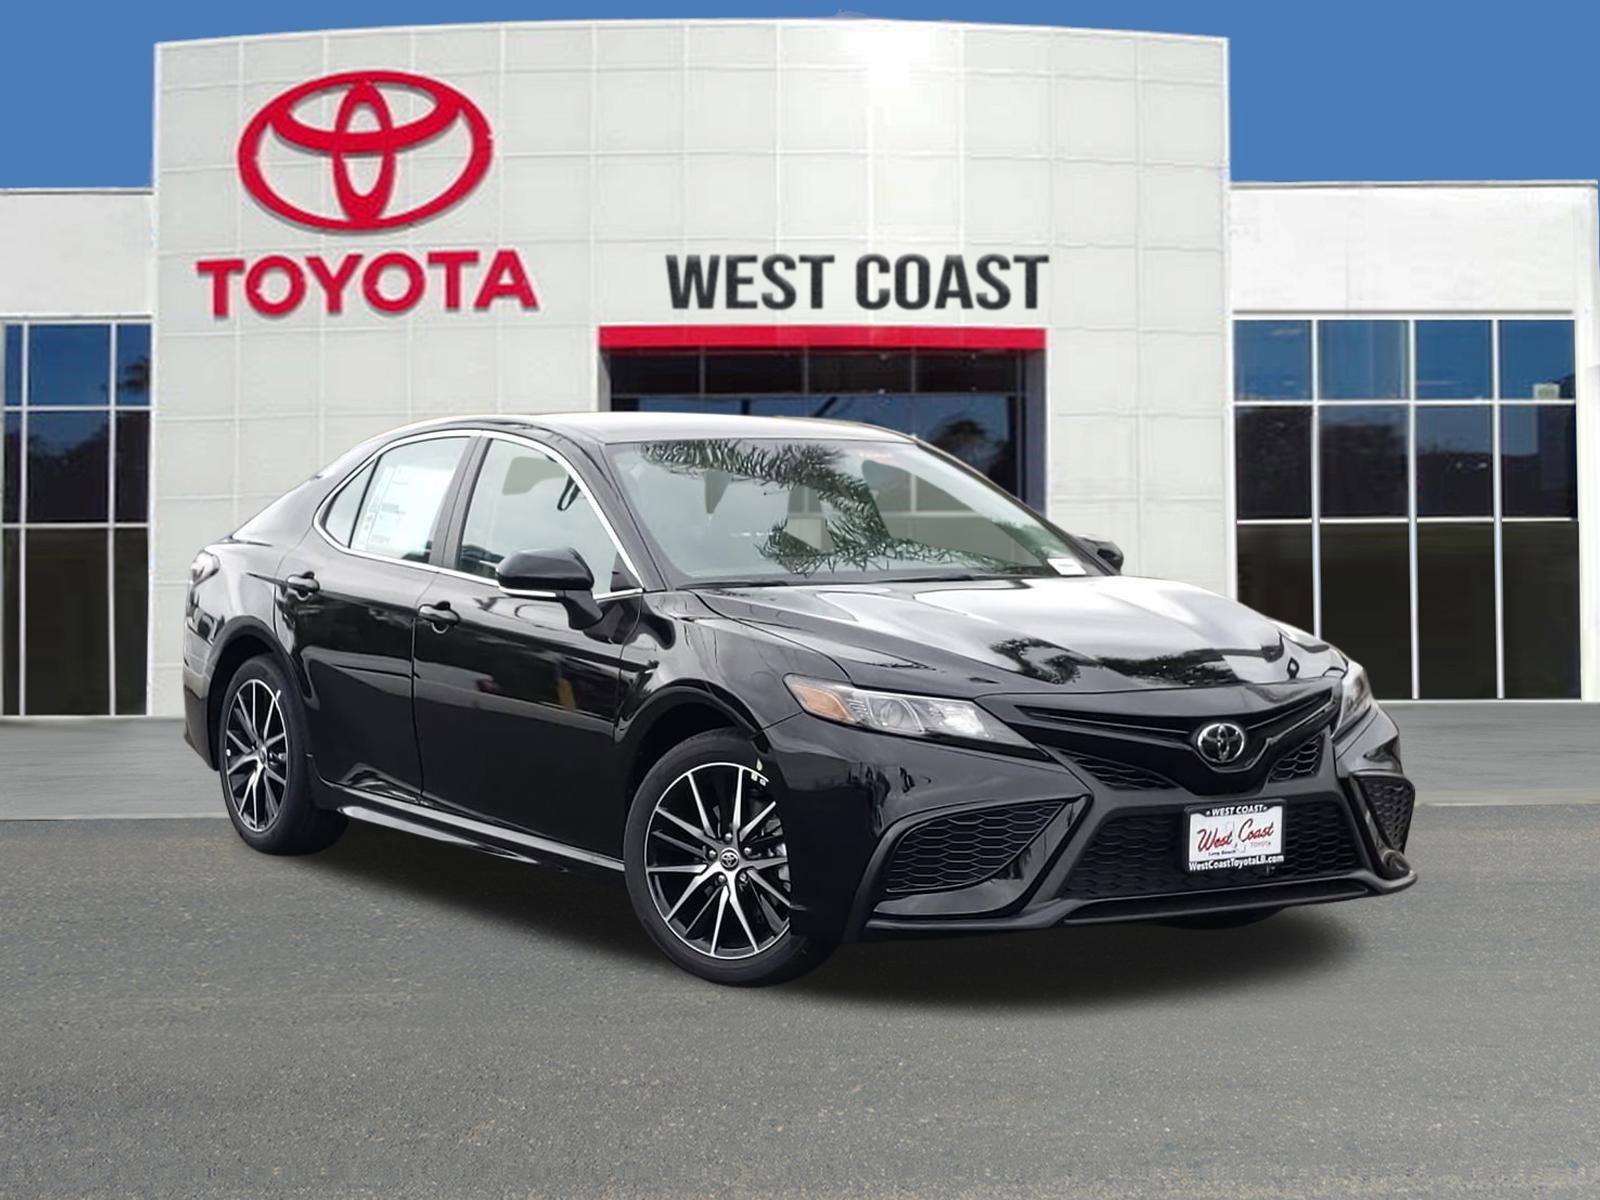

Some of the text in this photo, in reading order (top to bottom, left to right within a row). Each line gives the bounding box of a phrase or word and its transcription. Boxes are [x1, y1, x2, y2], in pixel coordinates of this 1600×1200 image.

[196, 250, 540, 319] TOYOTA
[665, 254, 1050, 310] WEST COAST
[1211, 804, 1264, 817] WEST COAST
[1197, 818, 1274, 852] West Coast
[1189, 855, 1284, 871] WestCoastToyotaLB.com
